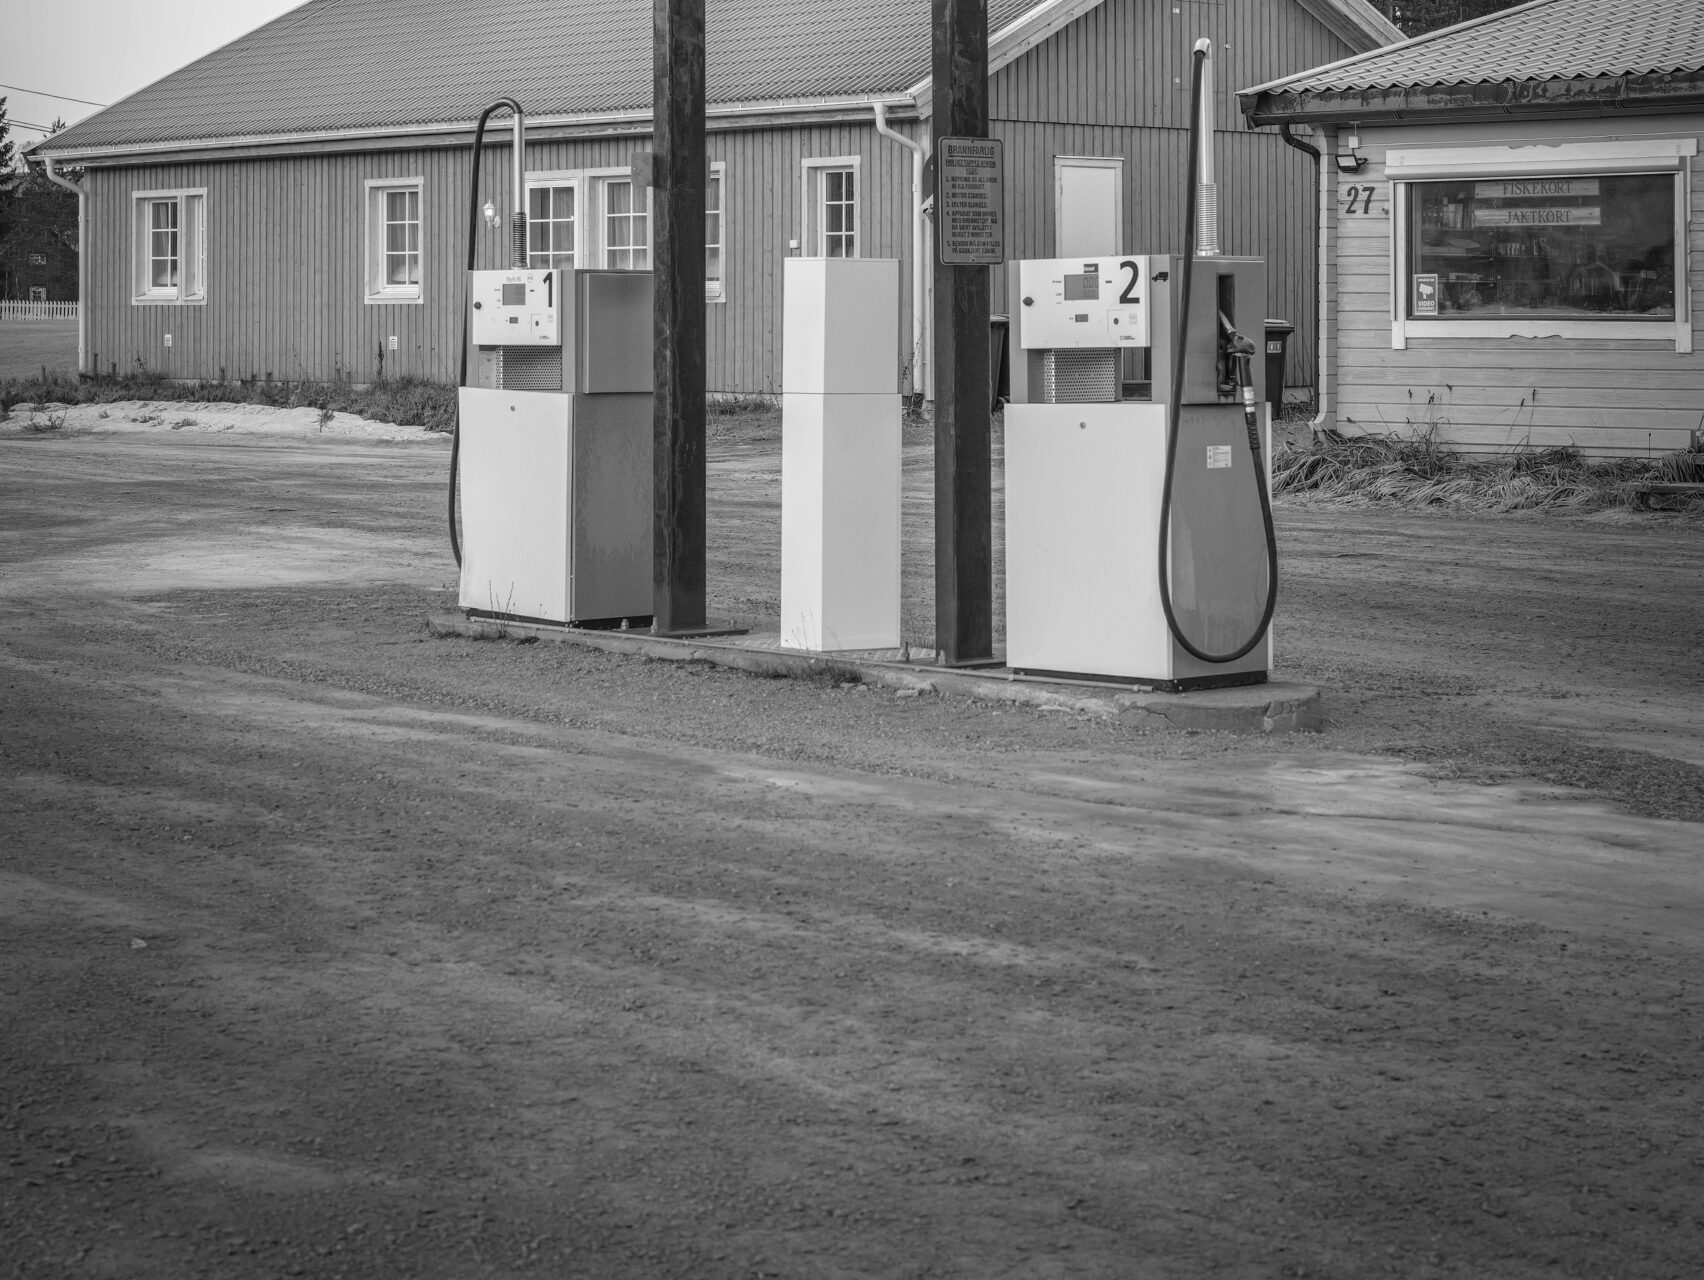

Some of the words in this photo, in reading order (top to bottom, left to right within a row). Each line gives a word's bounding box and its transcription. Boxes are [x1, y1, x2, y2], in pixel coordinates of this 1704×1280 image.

[947, 145, 995, 156] BRANNFARLIG
[1502, 181, 1573, 195] FISKEKORT
[1345, 186, 1376, 214] 27
[1504, 210, 1571, 224] JAKTKORT
[543, 272, 553, 308] 1
[1119, 260, 1140, 304] 2
